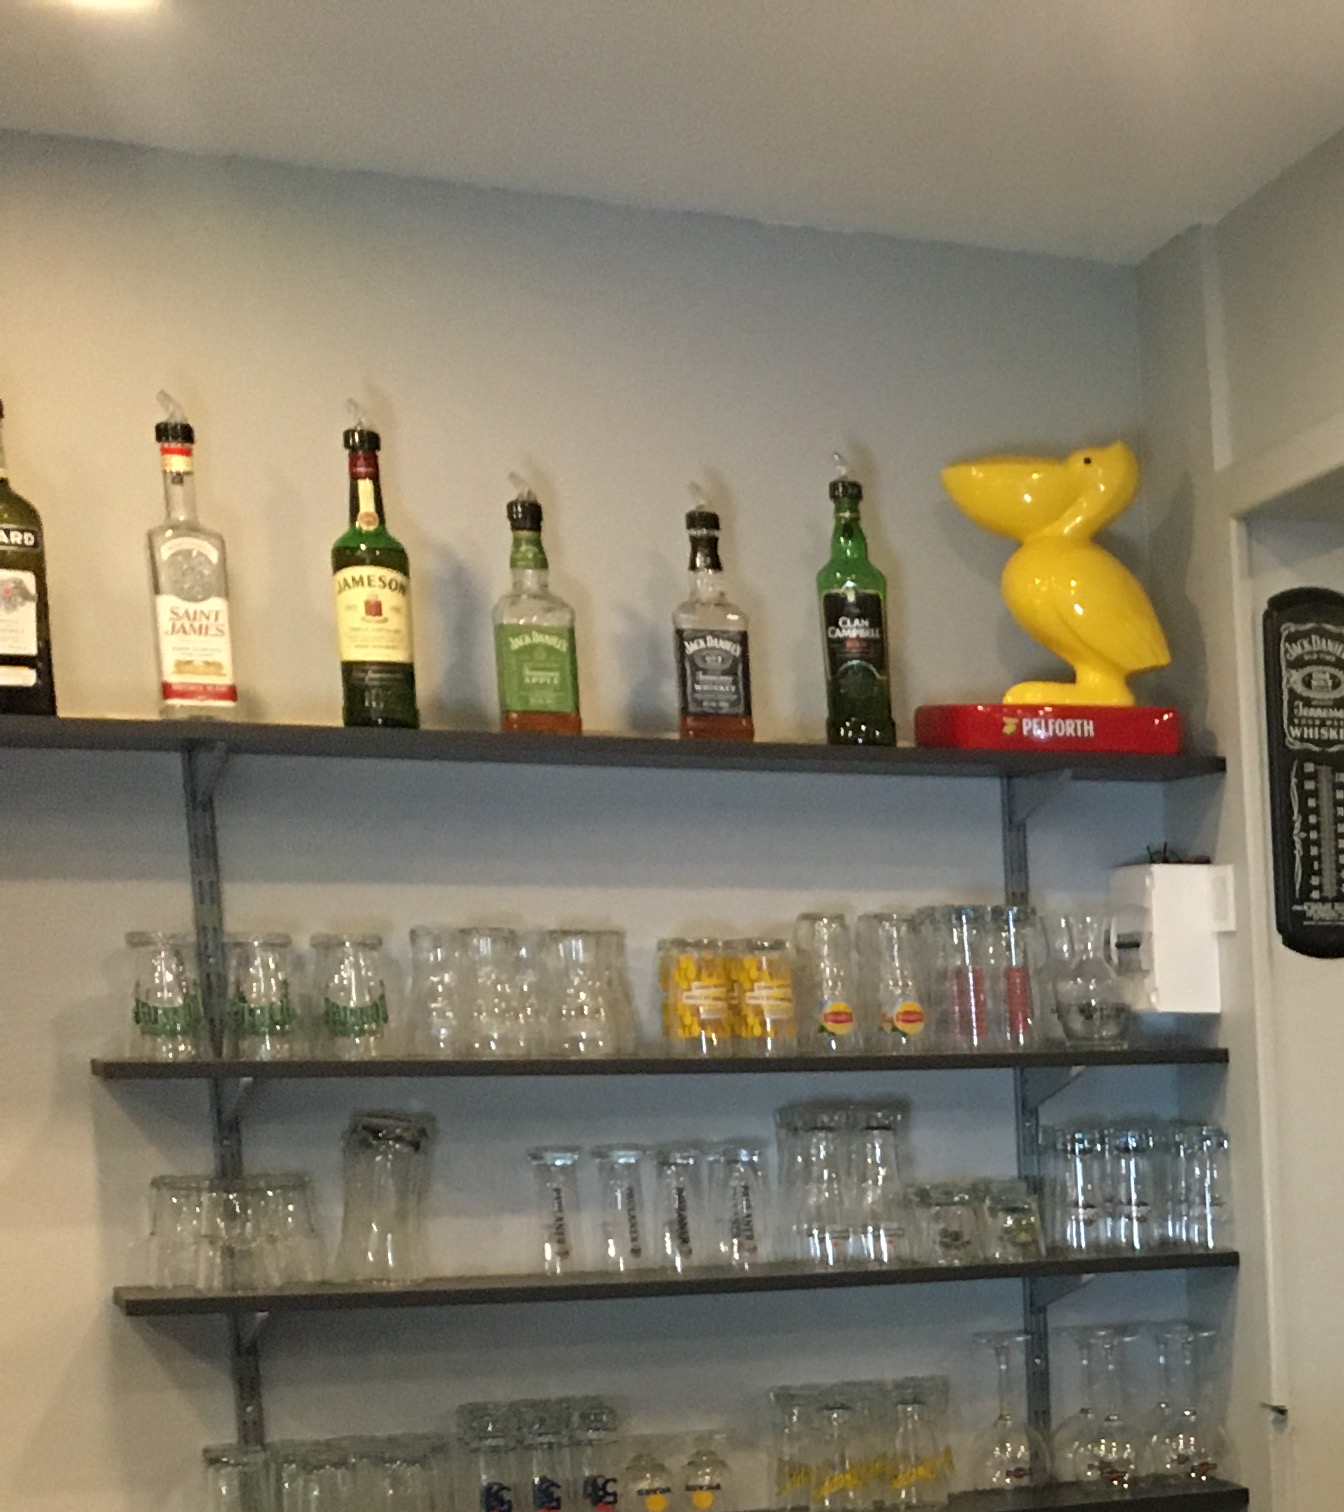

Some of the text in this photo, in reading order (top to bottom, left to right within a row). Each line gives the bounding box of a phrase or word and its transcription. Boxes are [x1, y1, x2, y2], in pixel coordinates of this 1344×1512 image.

[0, 529, 36, 547] ARD
[337, 574, 407, 596] JAMESON
[169, 605, 223, 622] SAINT
[838, 615, 870, 629] CLAN
[165, 622, 226, 638] JAMES
[1021, 717, 1096, 738] PELFORTH
